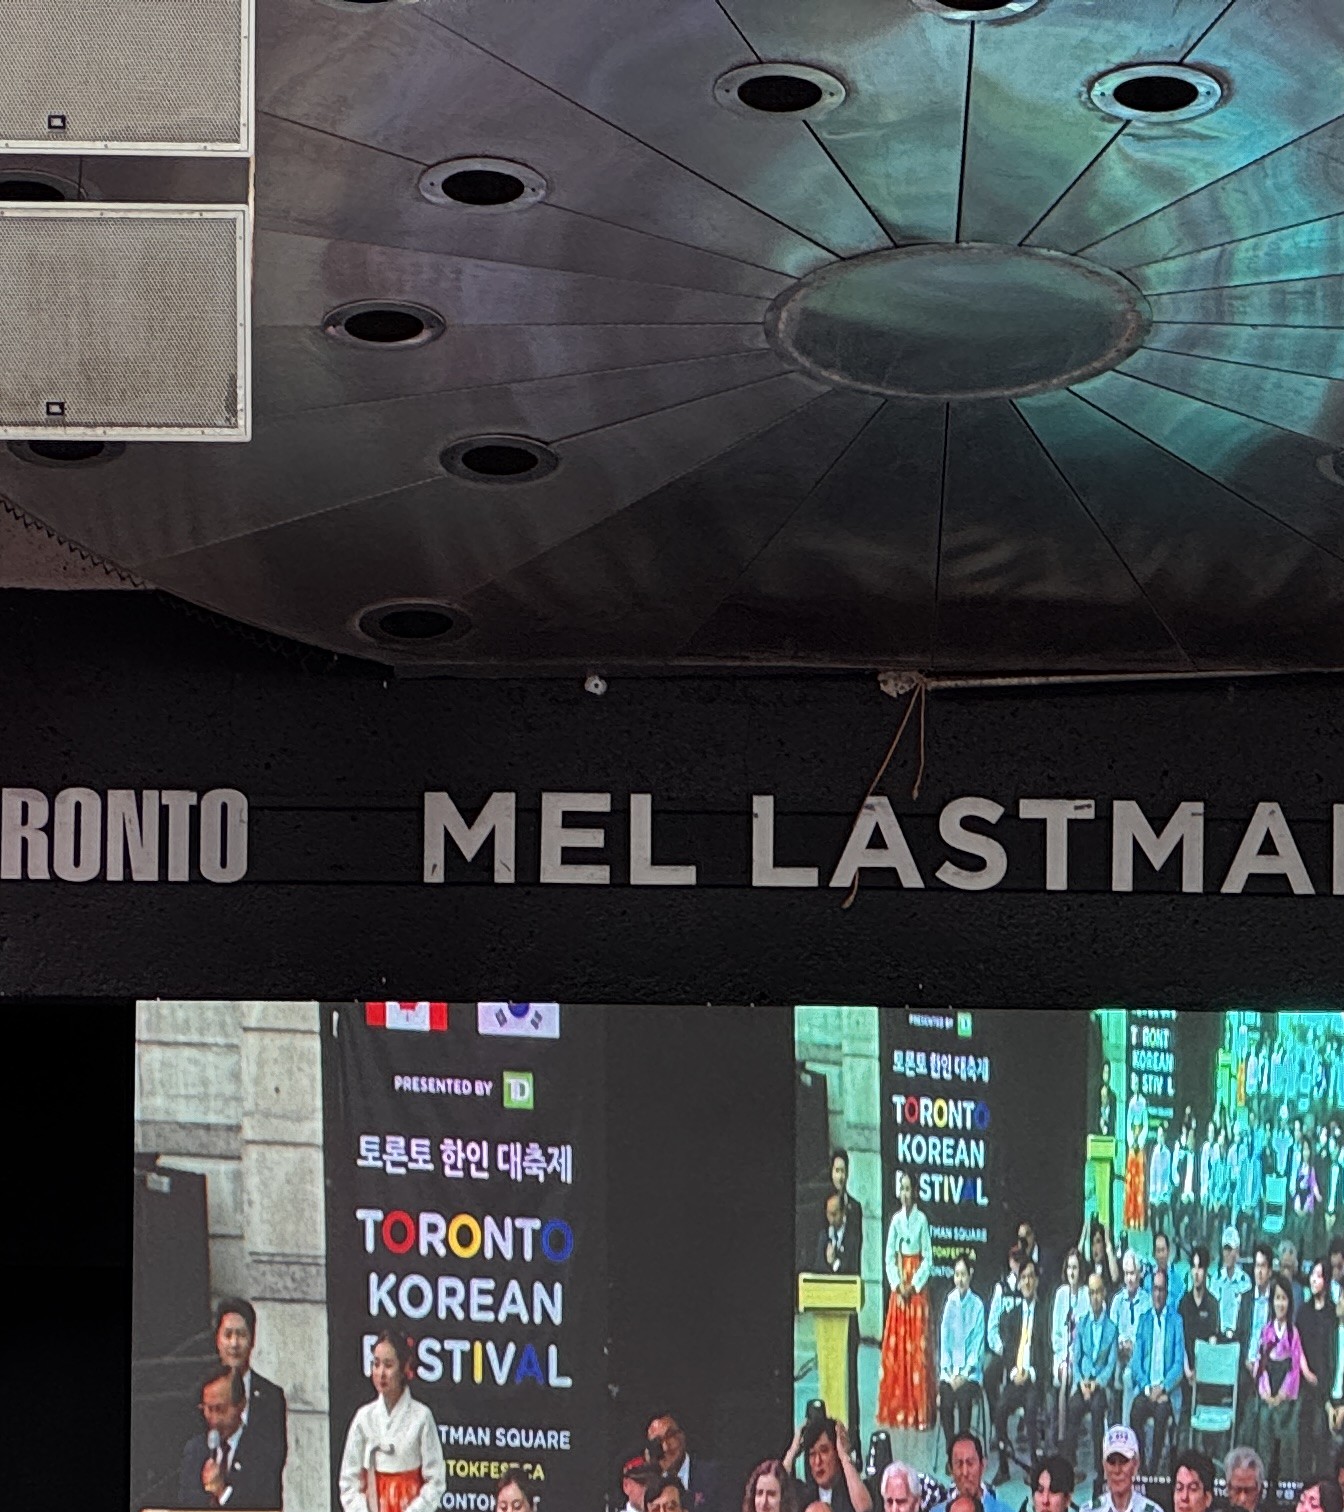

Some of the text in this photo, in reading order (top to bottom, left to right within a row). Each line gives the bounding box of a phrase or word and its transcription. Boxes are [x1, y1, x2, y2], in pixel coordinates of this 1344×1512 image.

[422, 791, 697, 887] MEL
[891, 1094, 991, 1131] TORONTO
[356, 1134, 573, 1184] 토론토 한인 대축제
[897, 1132, 985, 1170] KOREAN
[356, 1208, 574, 1263] TORONTO
[368, 1271, 563, 1326] KOREAN
[362, 1334, 573, 1388] FSTIVAL
[495, 1427, 572, 1450] SQUARE
